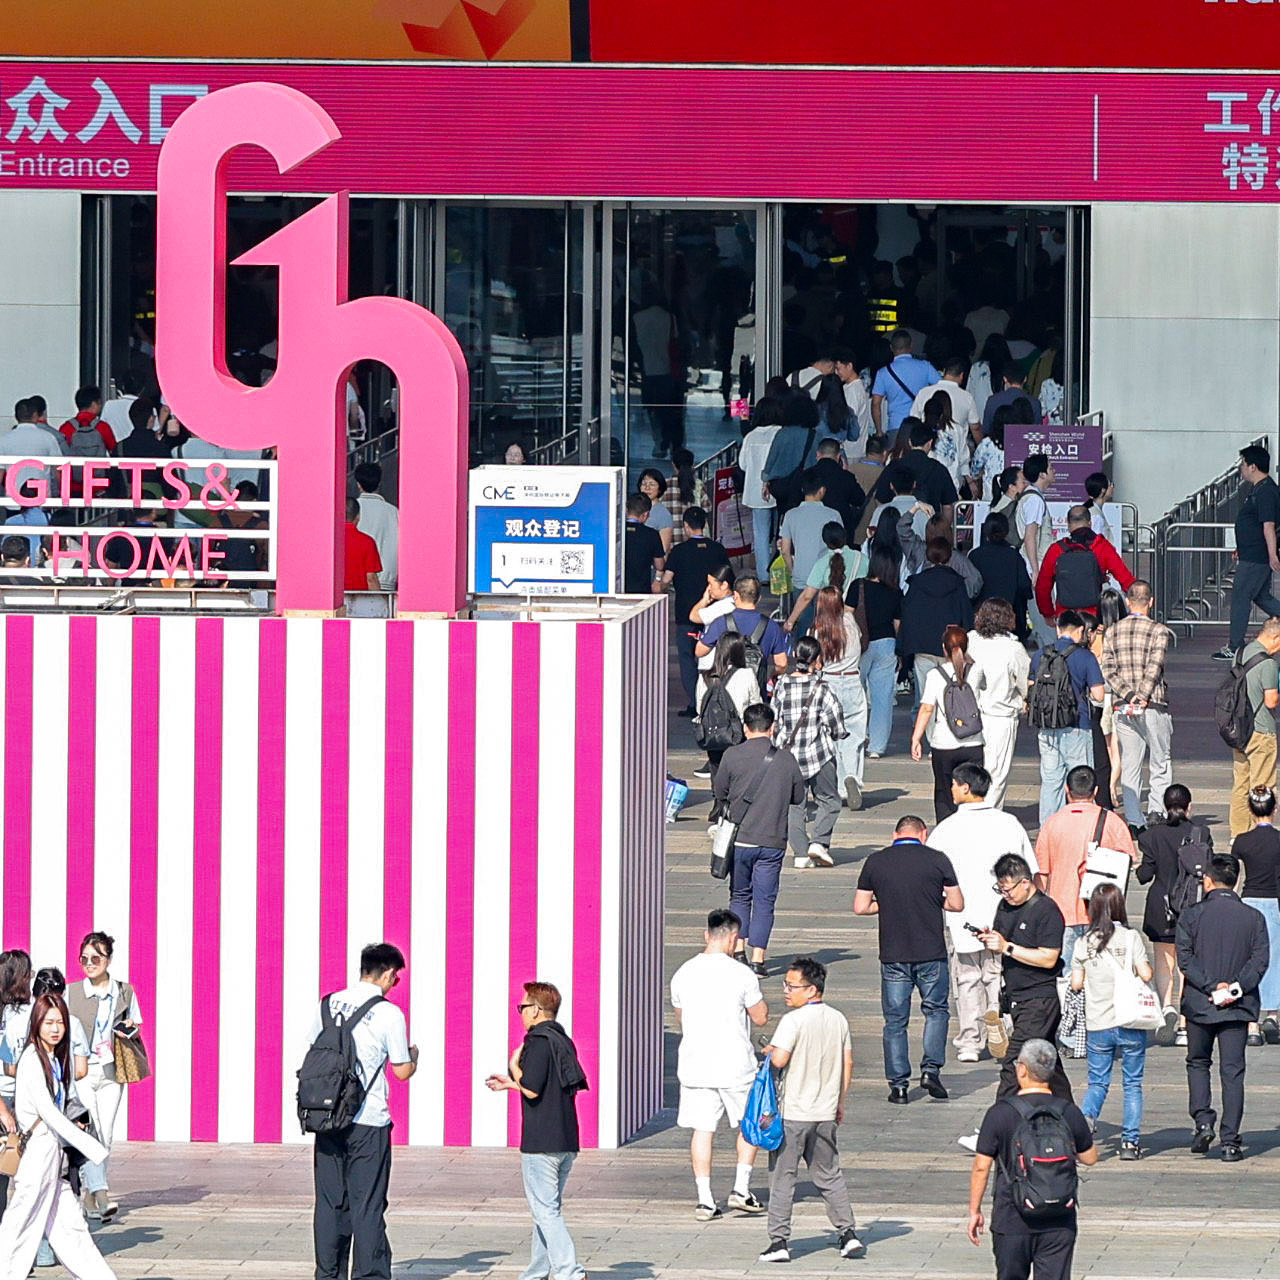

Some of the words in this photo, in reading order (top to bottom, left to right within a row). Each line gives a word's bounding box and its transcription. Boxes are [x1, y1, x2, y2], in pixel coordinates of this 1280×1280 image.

[1028, 443, 1079, 456] 安检入口
[482, 485, 516, 500] CME
[505, 518, 581, 538] 观众登记
[52, 530, 229, 580] HOME
